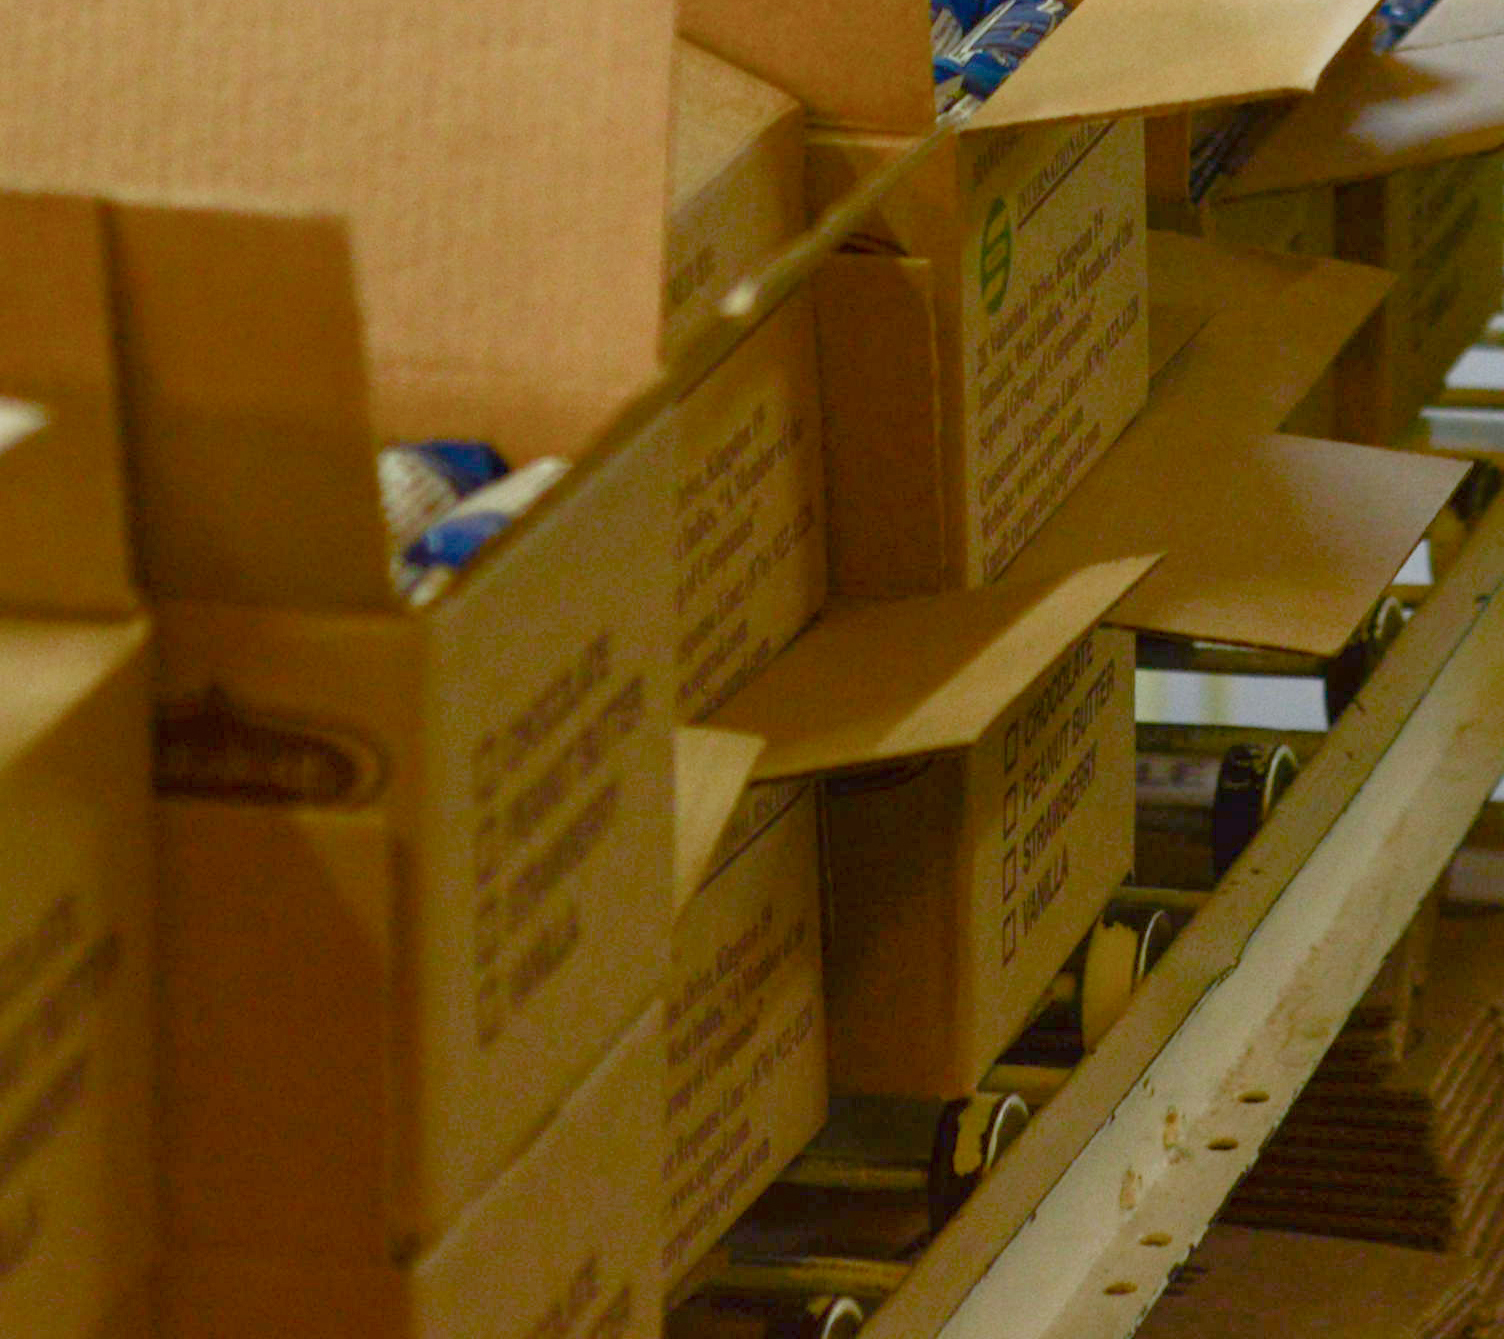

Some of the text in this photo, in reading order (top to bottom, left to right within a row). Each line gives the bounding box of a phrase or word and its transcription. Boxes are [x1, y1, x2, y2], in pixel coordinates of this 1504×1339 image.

[1023, 654, 1114, 814] PEANUT BUTTER
[1024, 627, 1093, 752] CHOCOLATE
[1023, 739, 1097, 878] STRAWBERRY
[1023, 836, 1068, 939] VANILLA
